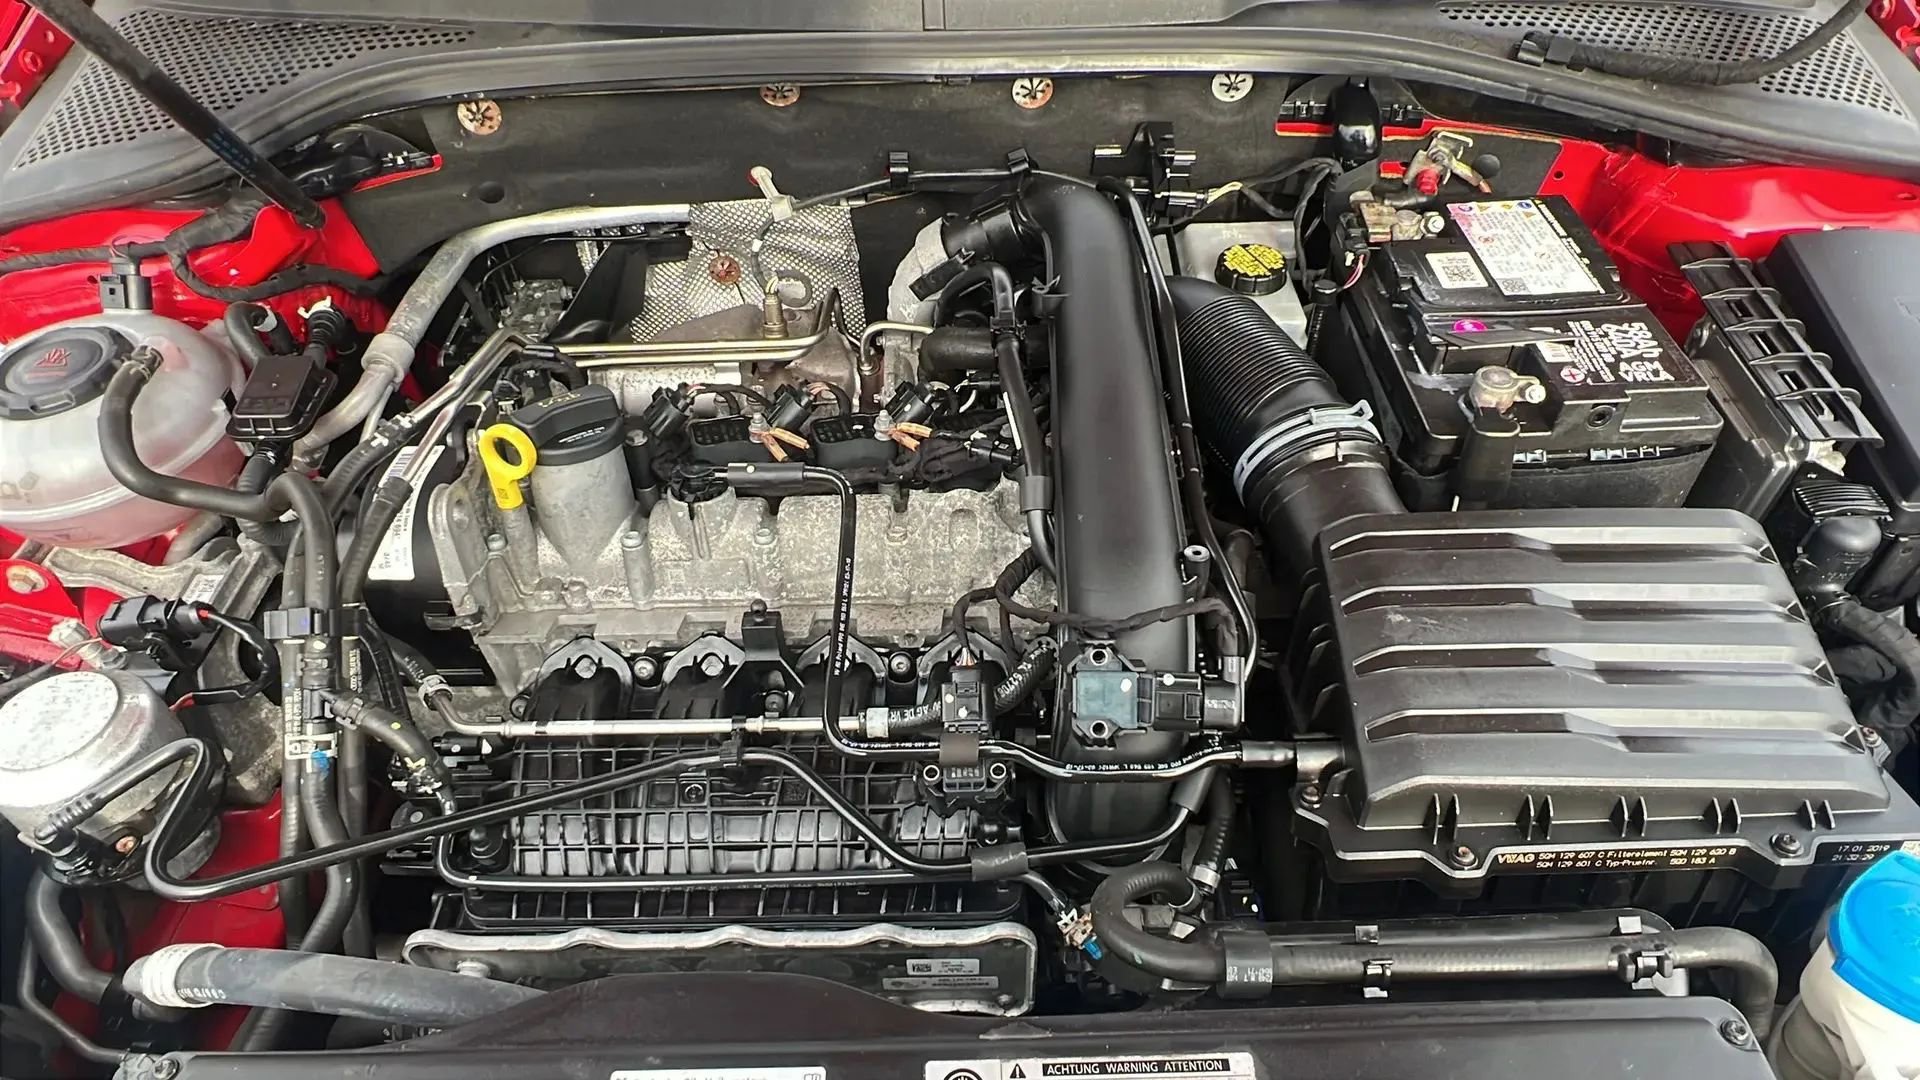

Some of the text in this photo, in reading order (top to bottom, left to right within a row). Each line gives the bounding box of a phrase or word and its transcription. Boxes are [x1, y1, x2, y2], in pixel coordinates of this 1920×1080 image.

[1619, 360, 1664, 372] AGM
[1618, 370, 1676, 382] VRLA
[903, 707, 916, 720] DE
[1578, 851, 1596, 859] 607
[1594, 859, 1602, 867] C
[1709, 857, 1717, 865] A
[1046, 1060, 1223, 1075] ACHTUNG WARNING ATTENTION
